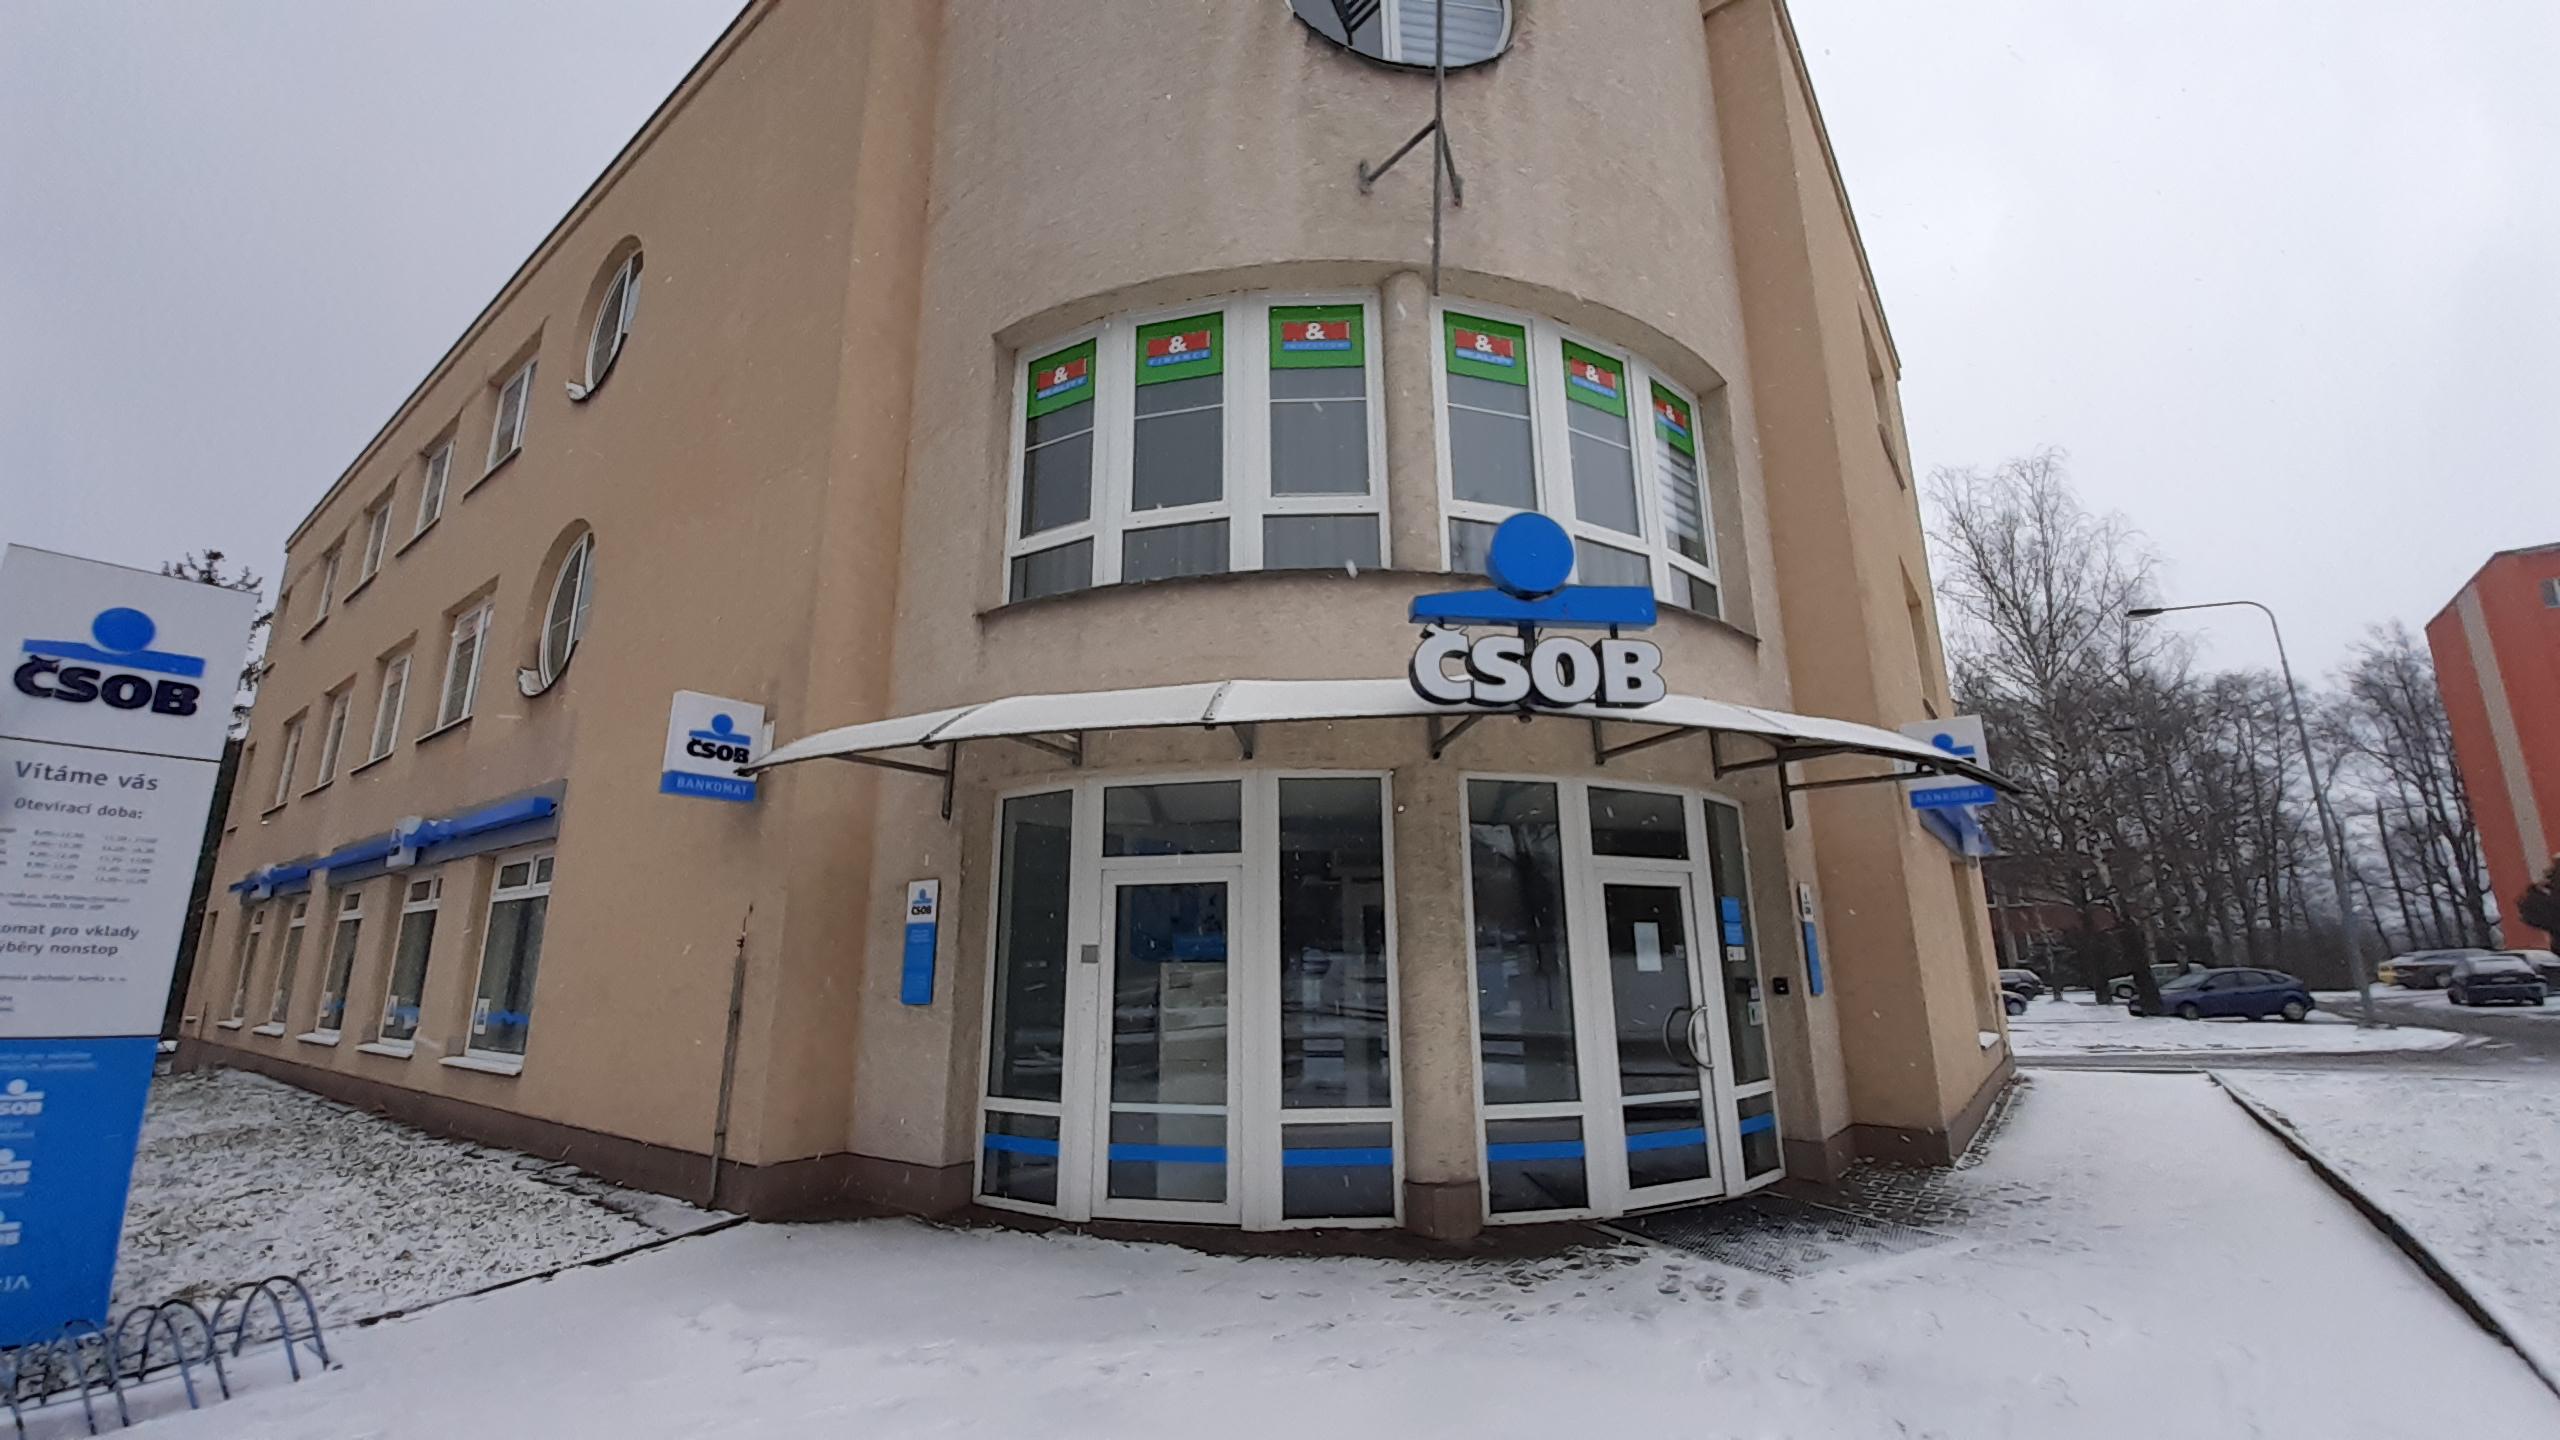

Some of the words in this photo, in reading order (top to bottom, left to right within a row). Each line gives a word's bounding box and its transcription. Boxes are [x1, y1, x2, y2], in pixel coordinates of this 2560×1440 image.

[1411, 623, 1667, 706] ČSOB
[14, 655, 200, 716] ČSOB
[686, 738, 749, 764] ČSOB
[16, 760, 108, 786] Vítáme
[118, 773, 158, 791] vás
[676, 776, 747, 796] BANKOMAT
[14, 797, 91, 815] Otevírací
[97, 805, 143, 819] doba:
[0, 924, 45, 935] omat
[50, 926, 79, 937] pro
[85, 925, 140, 940] vklady
[50, 944, 118, 957] nonstop
